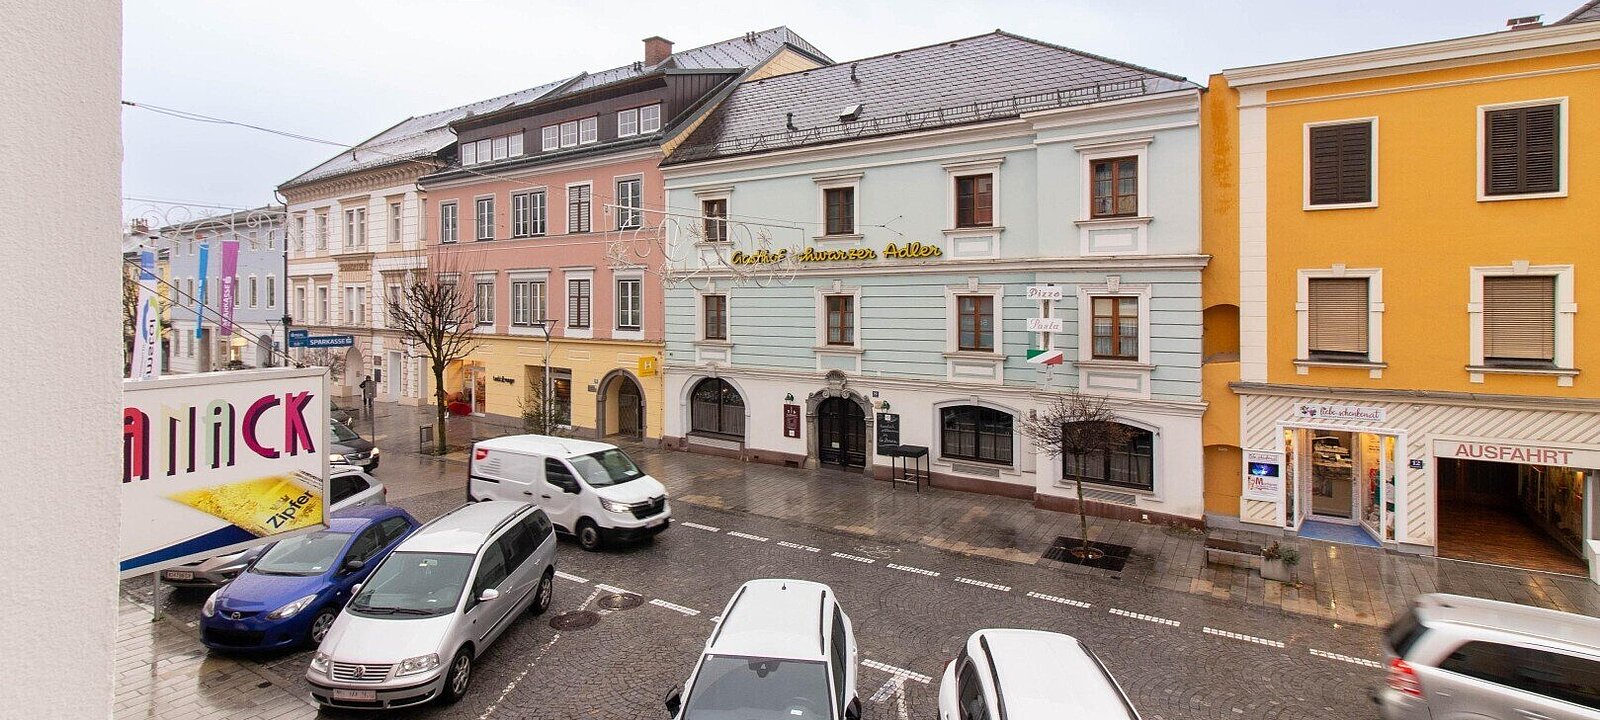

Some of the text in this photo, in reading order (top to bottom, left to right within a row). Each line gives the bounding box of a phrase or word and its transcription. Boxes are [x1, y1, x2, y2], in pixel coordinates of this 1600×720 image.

[732, 241, 943, 265] Gasthof chwarzer Adler
[1029, 318, 1060, 330] Pasta
[309, 338, 346, 346] SPARKASSE
[1455, 443, 1573, 465] AUSFAHRT
[265, 490, 314, 529] Zipfer
